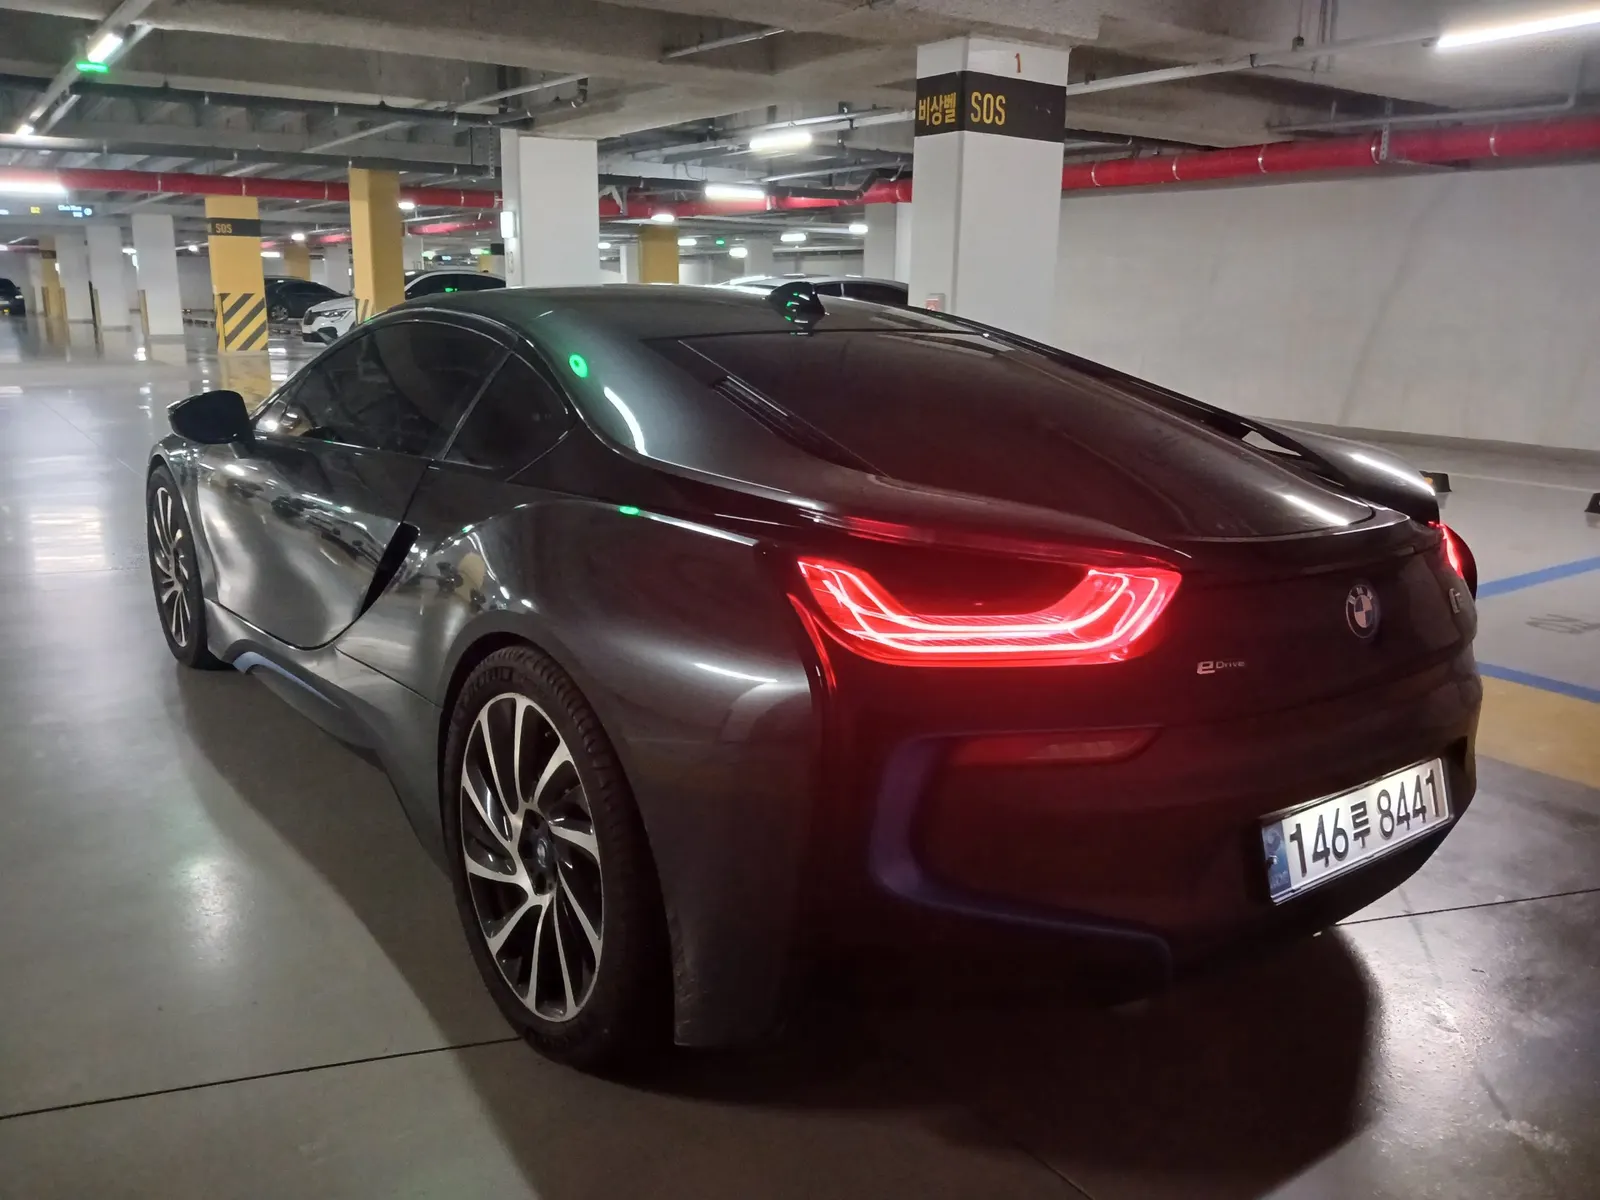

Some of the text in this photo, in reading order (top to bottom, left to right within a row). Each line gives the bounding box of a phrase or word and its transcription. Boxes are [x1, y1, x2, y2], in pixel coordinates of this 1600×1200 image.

[1014, 52, 1022, 74] 1
[918, 91, 957, 126] 비상벨
[970, 91, 1006, 126] SOS
[215, 223, 233, 234] SOS
[1289, 768, 1440, 878] 146루 8441
